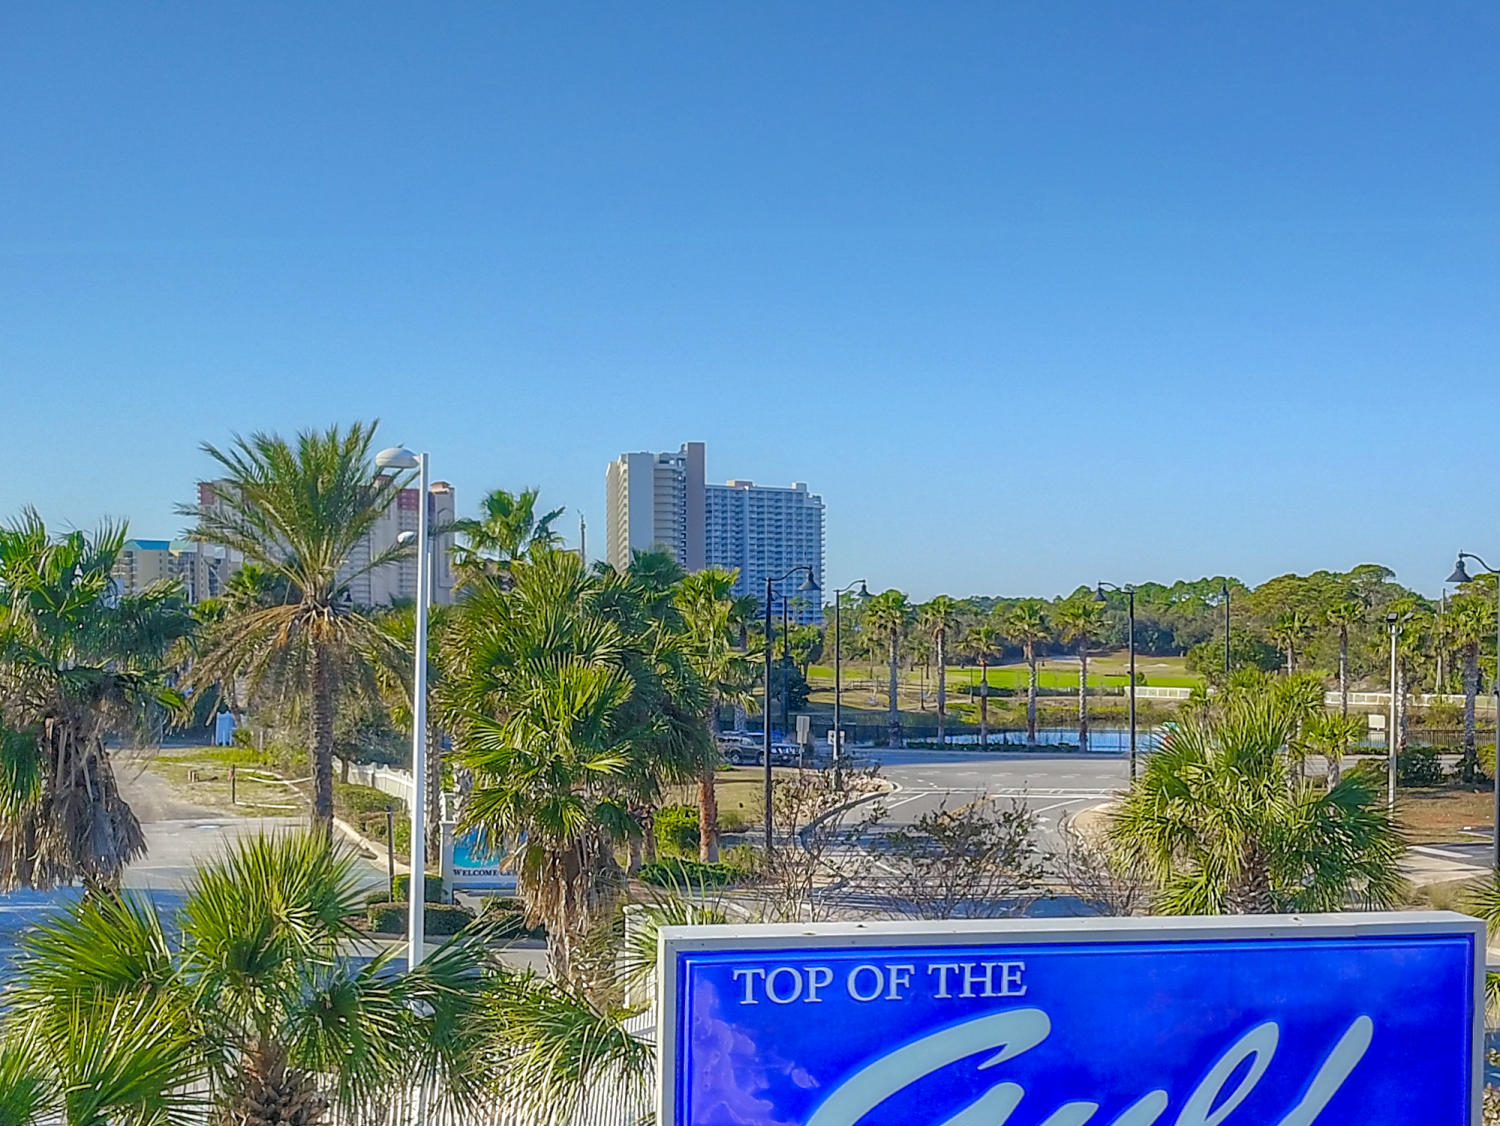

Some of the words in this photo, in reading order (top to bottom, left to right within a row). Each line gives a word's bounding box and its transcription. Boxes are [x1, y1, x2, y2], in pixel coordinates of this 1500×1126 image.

[453, 869, 497, 877] WELCOME
[733, 966, 834, 1005] TOP
[847, 964, 915, 1002] OF
[928, 961, 1027, 999] THE
